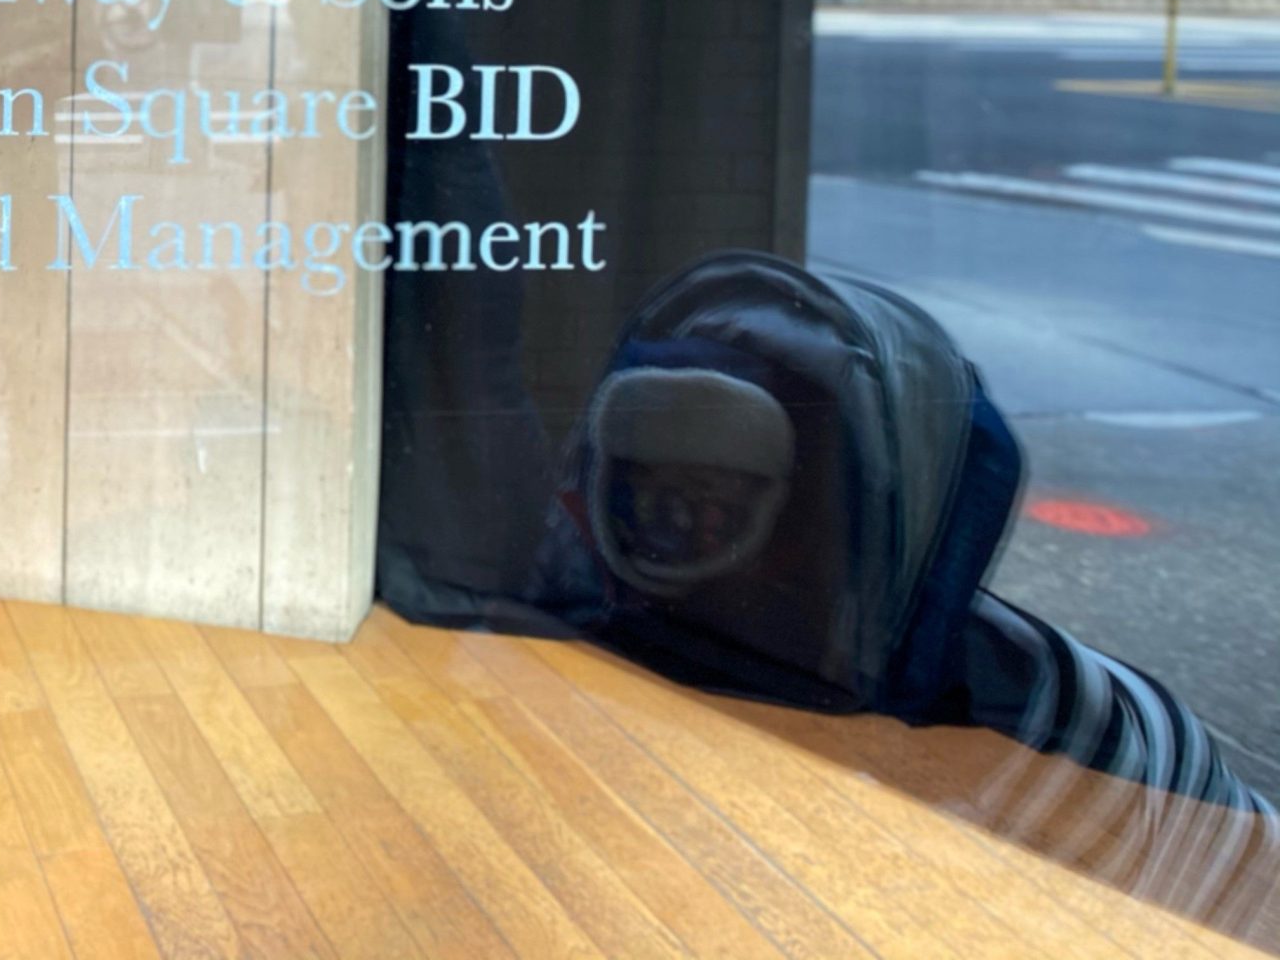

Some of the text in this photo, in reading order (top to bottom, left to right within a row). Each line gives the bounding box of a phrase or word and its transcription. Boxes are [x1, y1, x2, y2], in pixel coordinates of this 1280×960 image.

[83, 60, 377, 164] Square
[405, 63, 582, 141] BID
[47, 193, 606, 296] Management
